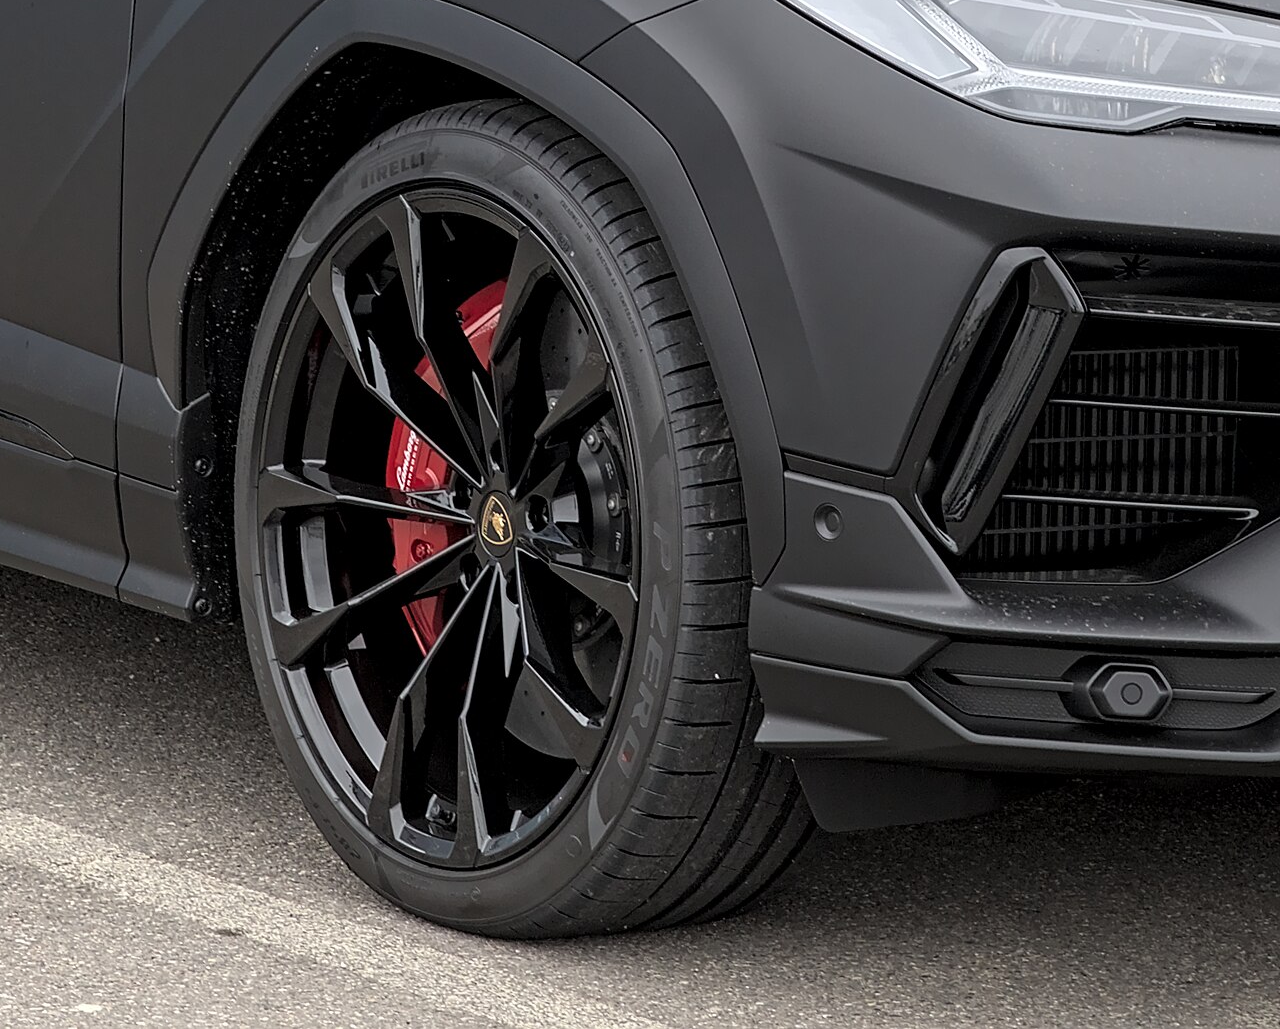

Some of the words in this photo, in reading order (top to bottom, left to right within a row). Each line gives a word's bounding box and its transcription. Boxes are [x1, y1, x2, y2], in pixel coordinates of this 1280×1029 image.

[396, 429, 417, 492] Lamborg
[652, 520, 671, 571] P
[617, 583, 669, 779] ZERO
